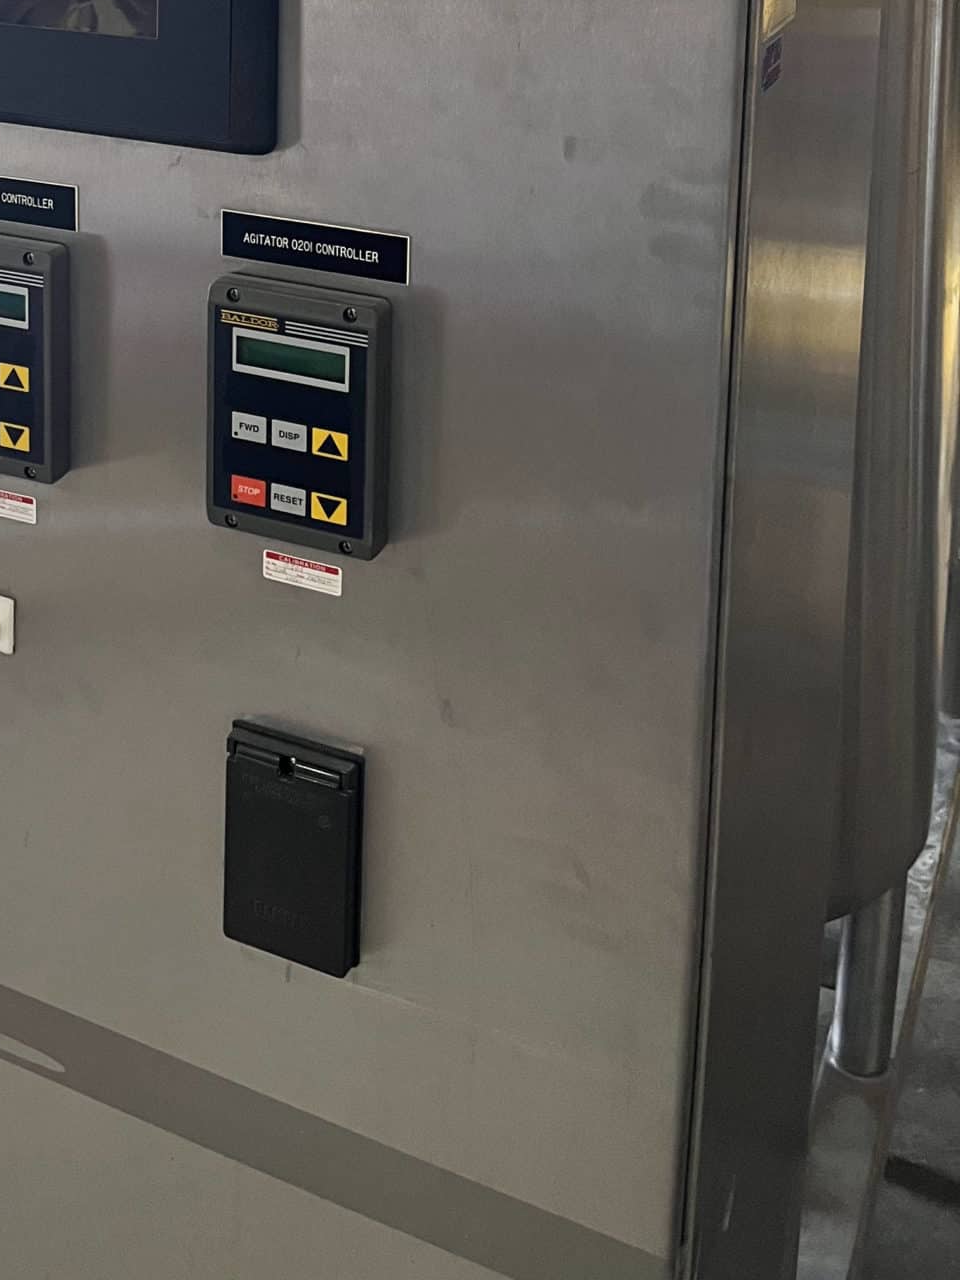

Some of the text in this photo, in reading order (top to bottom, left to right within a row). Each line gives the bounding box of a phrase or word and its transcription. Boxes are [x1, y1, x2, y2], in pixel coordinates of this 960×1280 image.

[1, 193, 54, 210] CONTROLLER
[243, 232, 289, 249] AGITATOR
[315, 243, 379, 264] CONTROLLER
[221, 311, 279, 329] BALDOR
[239, 422, 259, 433] FWD
[278, 430, 300, 440] DISP
[238, 485, 261, 496] STOP
[273, 493, 304, 506] RESET
